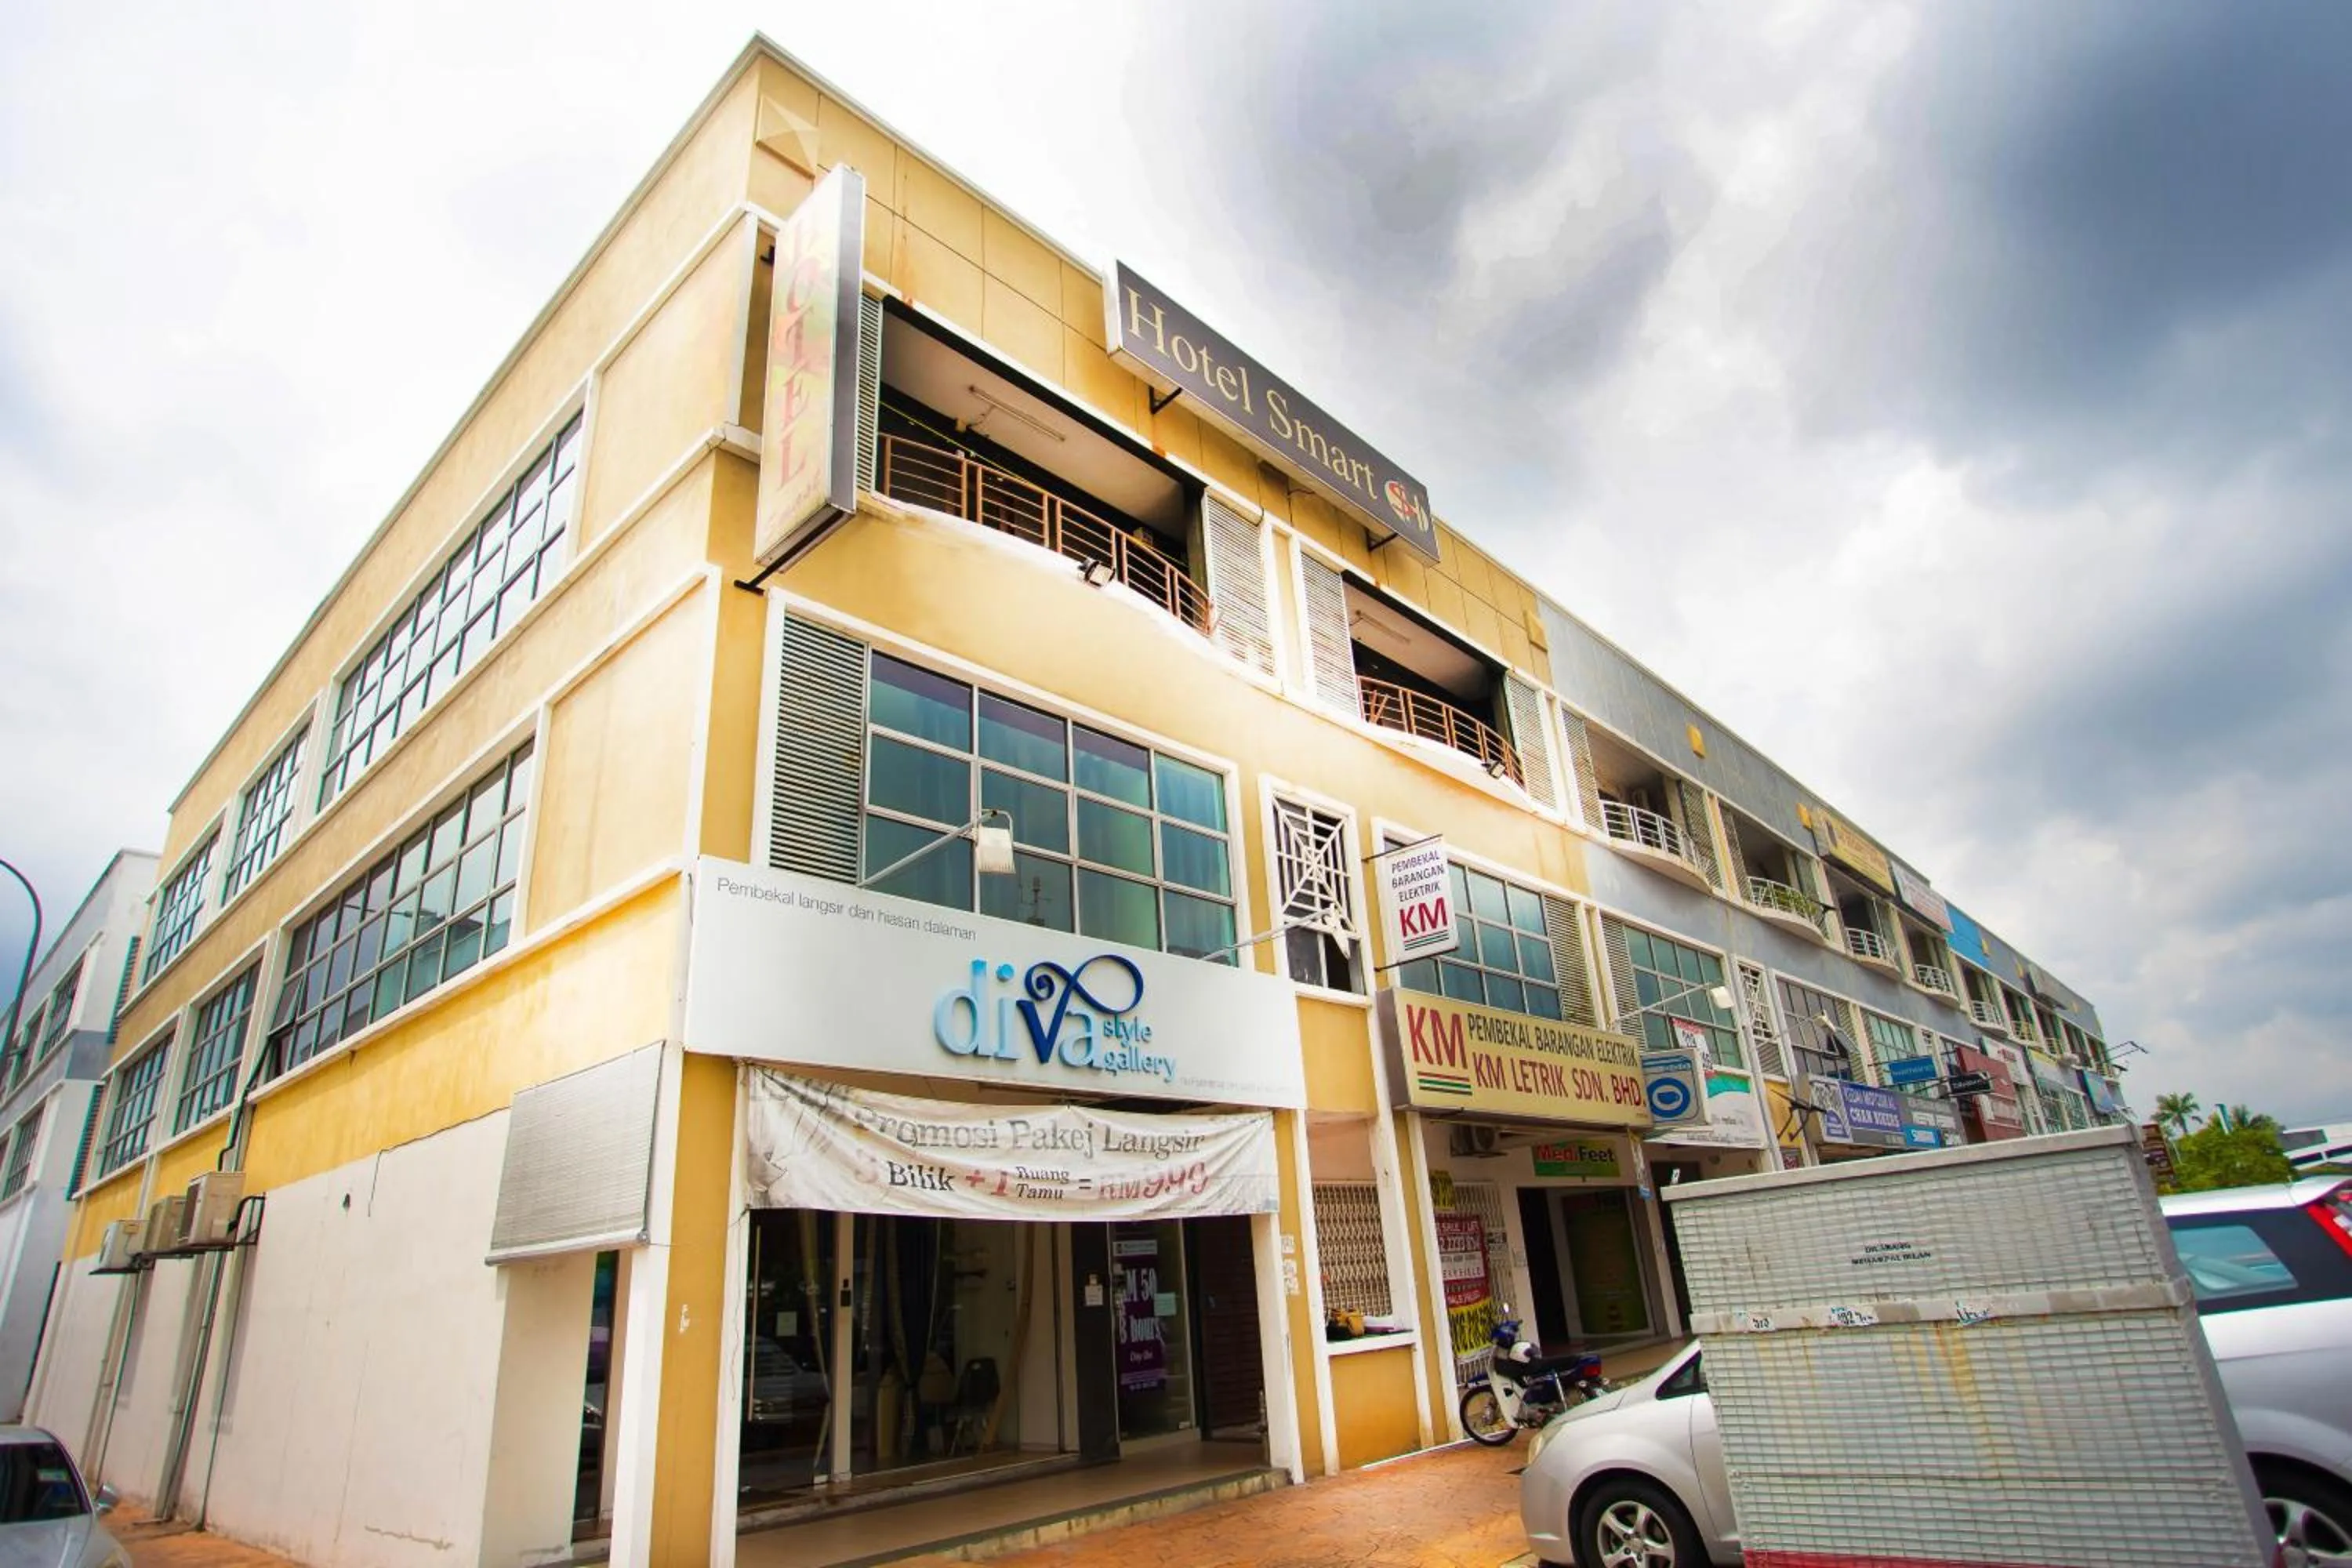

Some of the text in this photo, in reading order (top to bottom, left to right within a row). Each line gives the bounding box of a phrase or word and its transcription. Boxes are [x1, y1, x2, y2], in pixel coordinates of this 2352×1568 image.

[1126, 286, 1377, 499] Hotel Smart
[1391, 850, 1440, 873] PEMBEKAL
[1391, 865, 1445, 890] BARANGAN
[717, 877, 977, 942] Pembekal langsir dan hiasan dalaman
[1398, 882, 1441, 902] ELEKTRIK
[1399, 896, 1448, 938] KM
[934, 953, 1145, 1069] diva
[1102, 1012, 1152, 1045] style
[1406, 1004, 1468, 1070] KM
[1467, 1013, 1638, 1068] PEMBEKAL BARANGAN ELEKTRIK
[1102, 1045, 1177, 1083] gallery
[1472, 1052, 1647, 1108] KM LETRIK SDN. BHD.
[854, 1105, 1206, 1160] Promosi Pakej Langsir
[1537, 1142, 1614, 1163] MediFeet
[888, 1160, 955, 1192] Bilik
[1015, 1164, 1071, 1185] Ruang
[1016, 1183, 1065, 1201] Tamu
